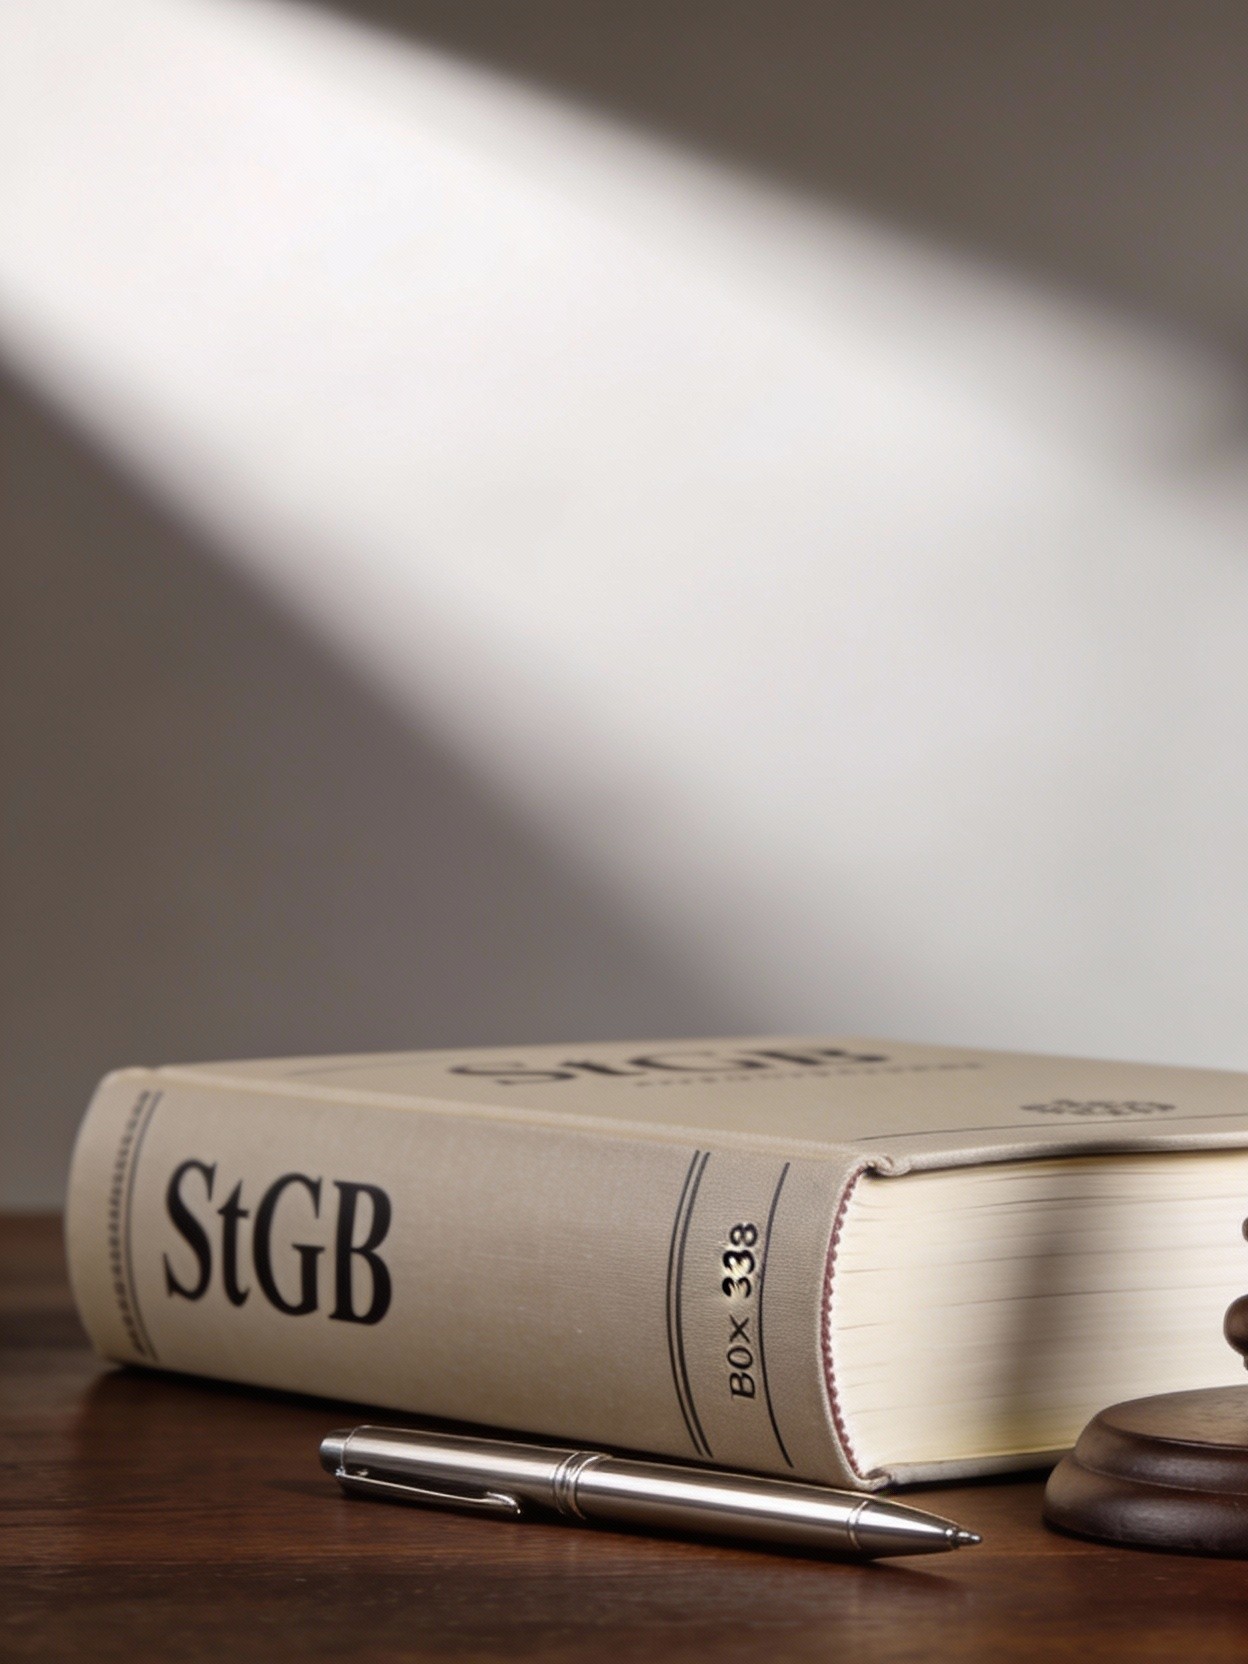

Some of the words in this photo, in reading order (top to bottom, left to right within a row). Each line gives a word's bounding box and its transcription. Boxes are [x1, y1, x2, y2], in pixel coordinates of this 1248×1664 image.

[449, 1046, 888, 1086] StGB
[164, 1160, 393, 1326] StGB
[722, 1223, 759, 1299] 338
